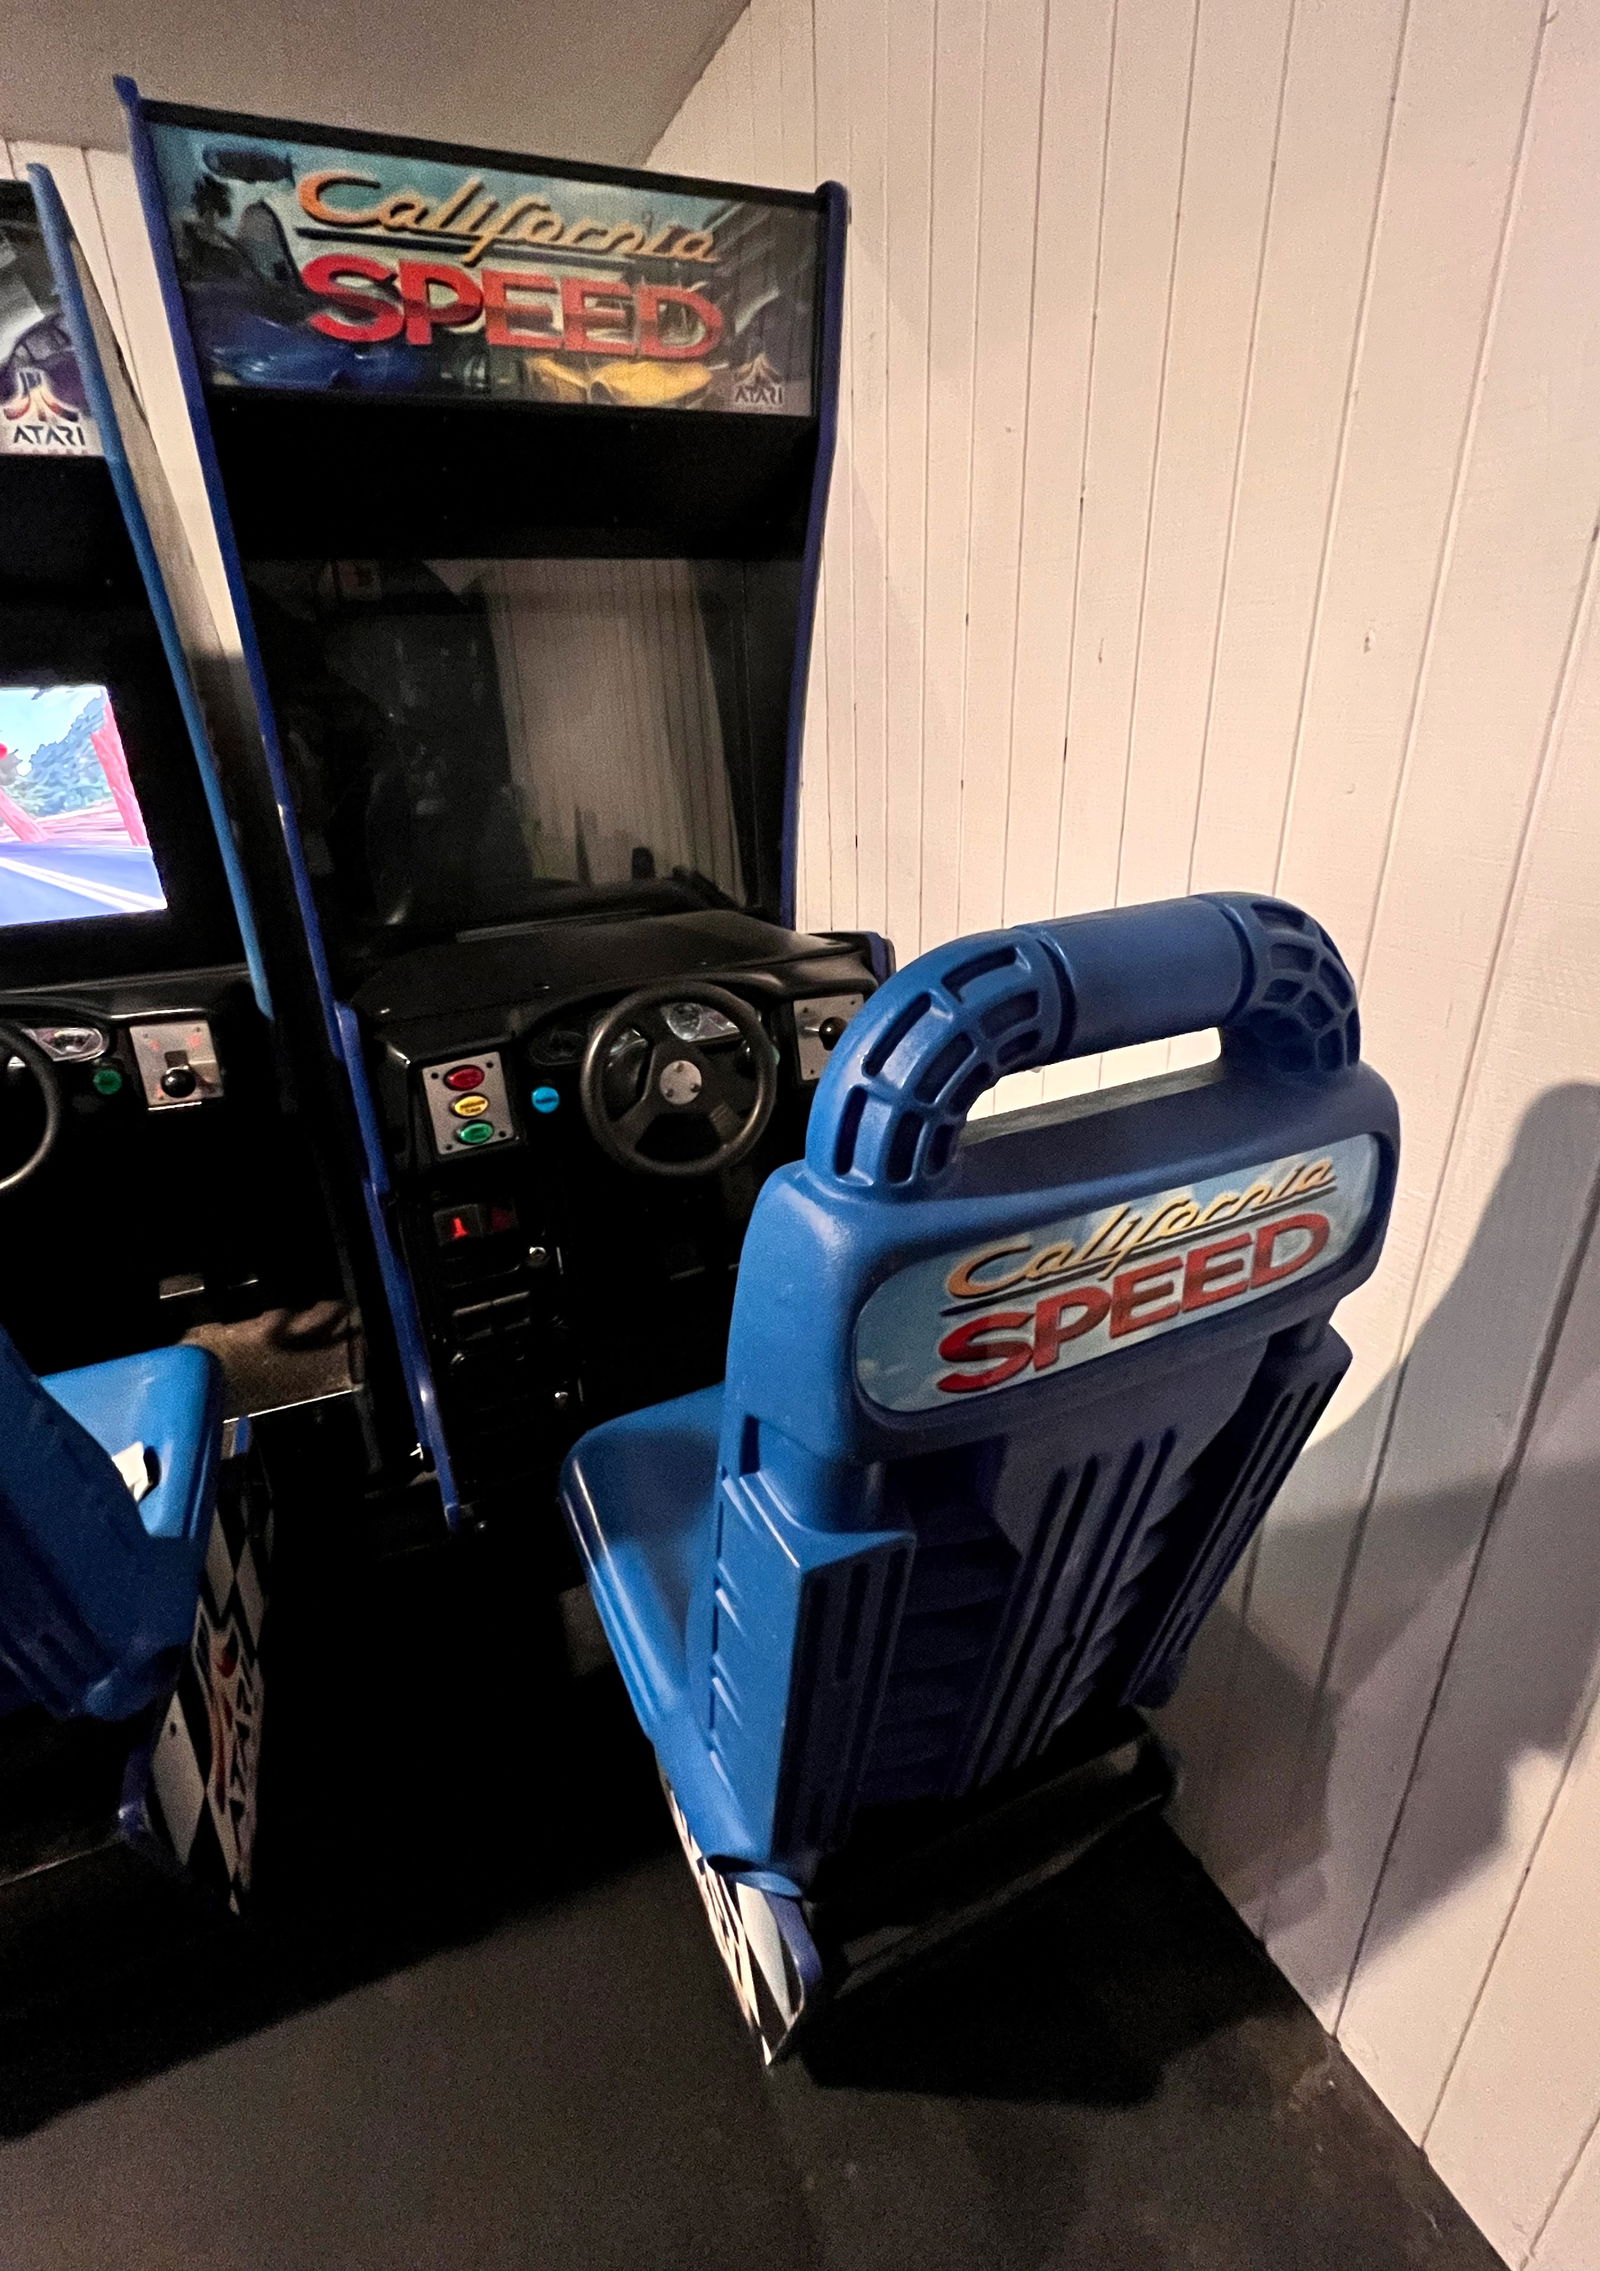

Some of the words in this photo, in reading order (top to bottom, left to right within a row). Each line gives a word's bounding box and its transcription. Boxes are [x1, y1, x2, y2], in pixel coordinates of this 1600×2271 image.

[297, 169, 717, 266] California
[300, 254, 722, 360] SPEED
[13, 424, 86, 446] ATARI
[735, 385, 783, 404] ATARI
[947, 1156, 1338, 1297] California
[935, 1212, 1331, 1393] SPEED
